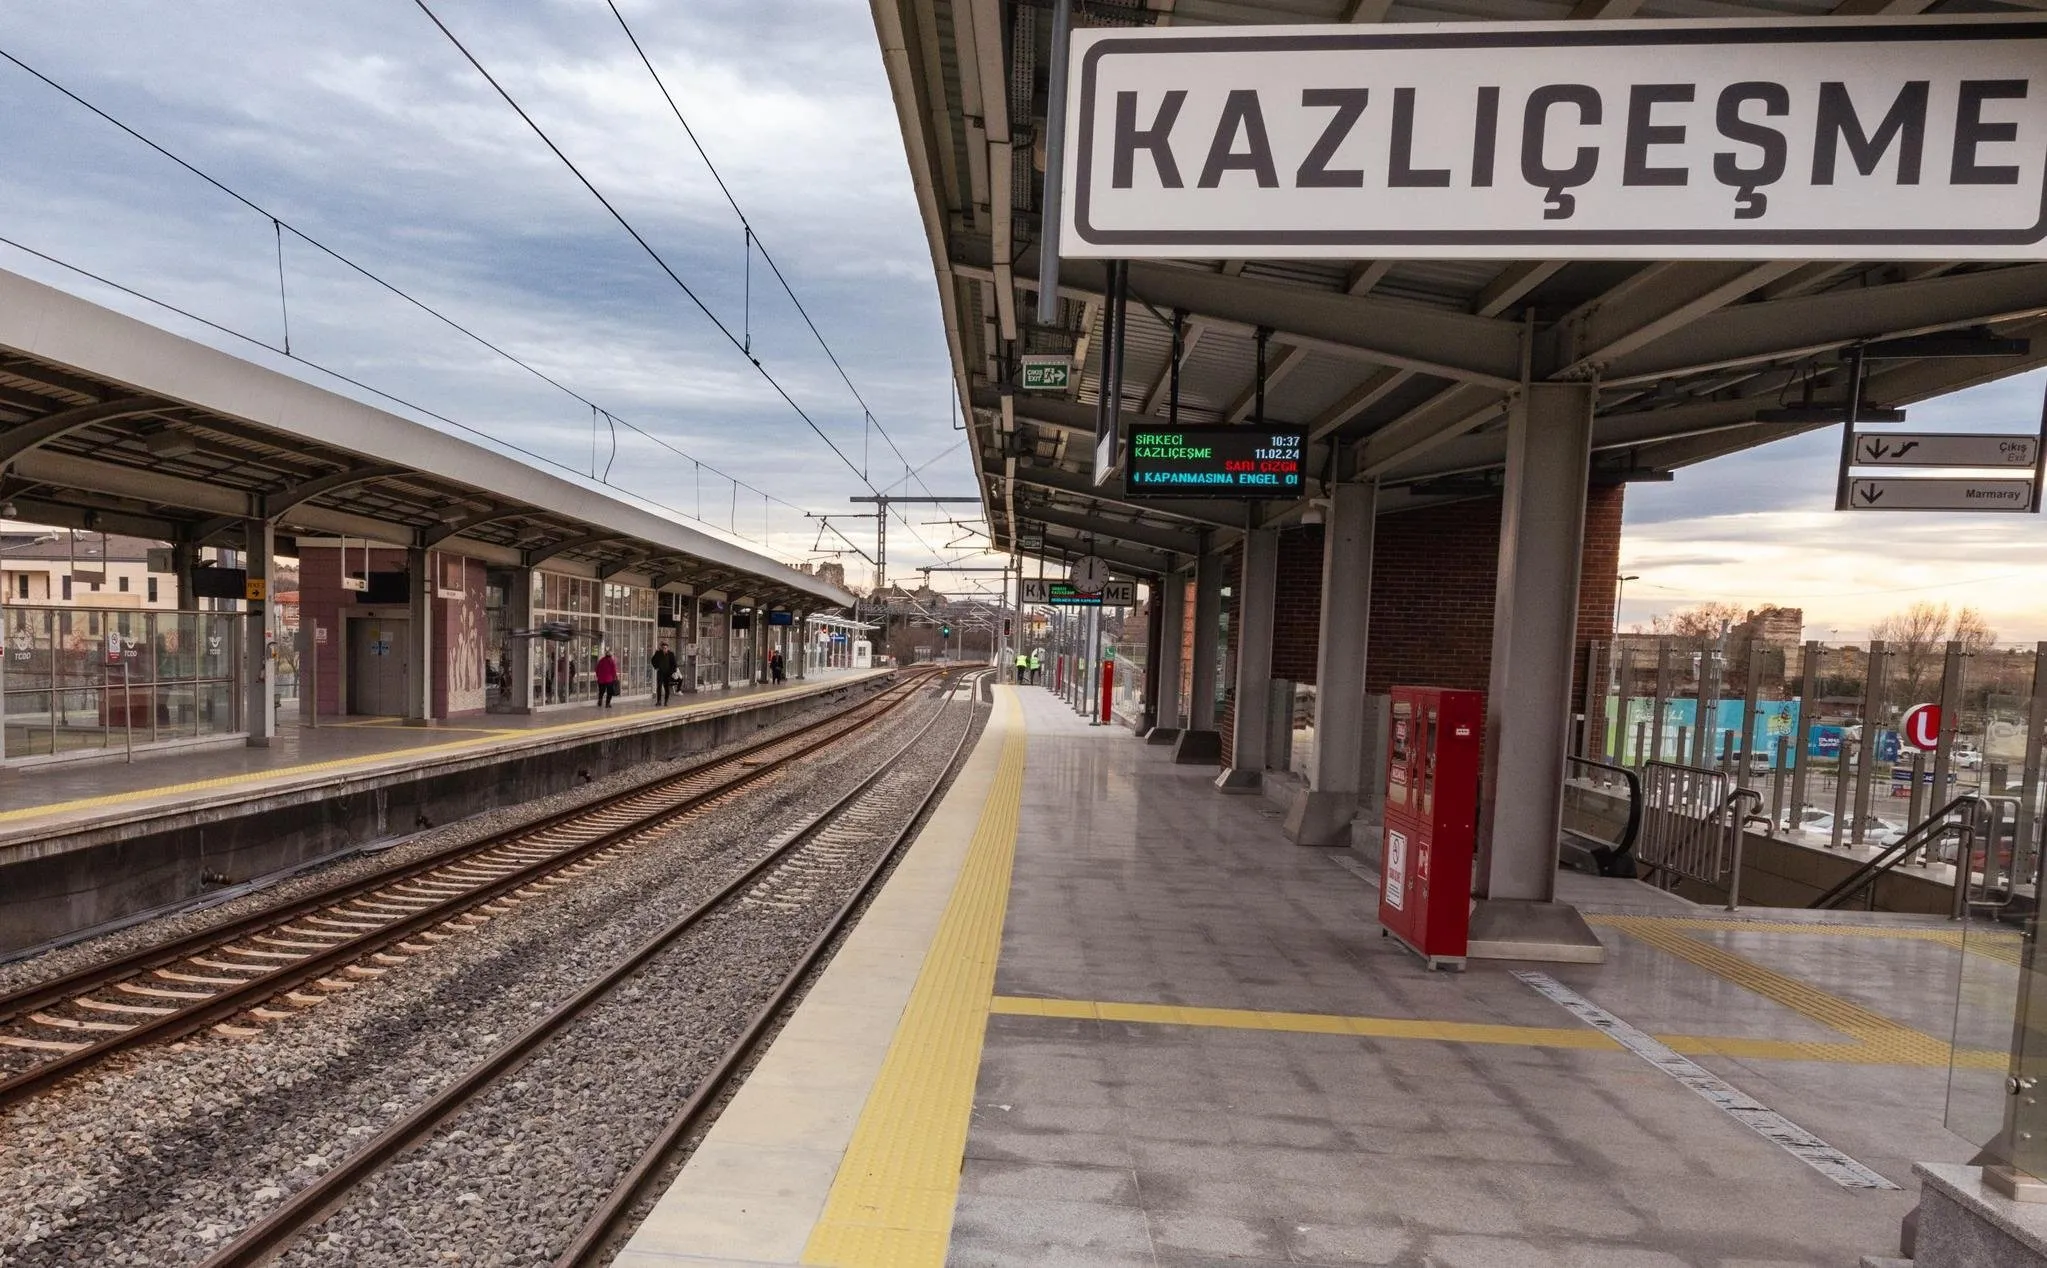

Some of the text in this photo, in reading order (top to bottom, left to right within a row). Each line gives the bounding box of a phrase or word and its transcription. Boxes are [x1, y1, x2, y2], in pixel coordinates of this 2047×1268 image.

[1111, 79, 2030, 220] KAZLIÇEŞME
[1271, 436, 1300, 447] 10:37
[1999, 441, 2027, 453] Çıkış
[1134, 447, 1212, 459] KAZLIÇEŞME
[1255, 448, 1300, 460] 11.02.24
[2008, 453, 2026, 462] Exit
[1145, 472, 1233, 484] KAPANMASINA
[1239, 473, 1279, 485] ENGEL
[1966, 489, 2021, 501] Marmaray
